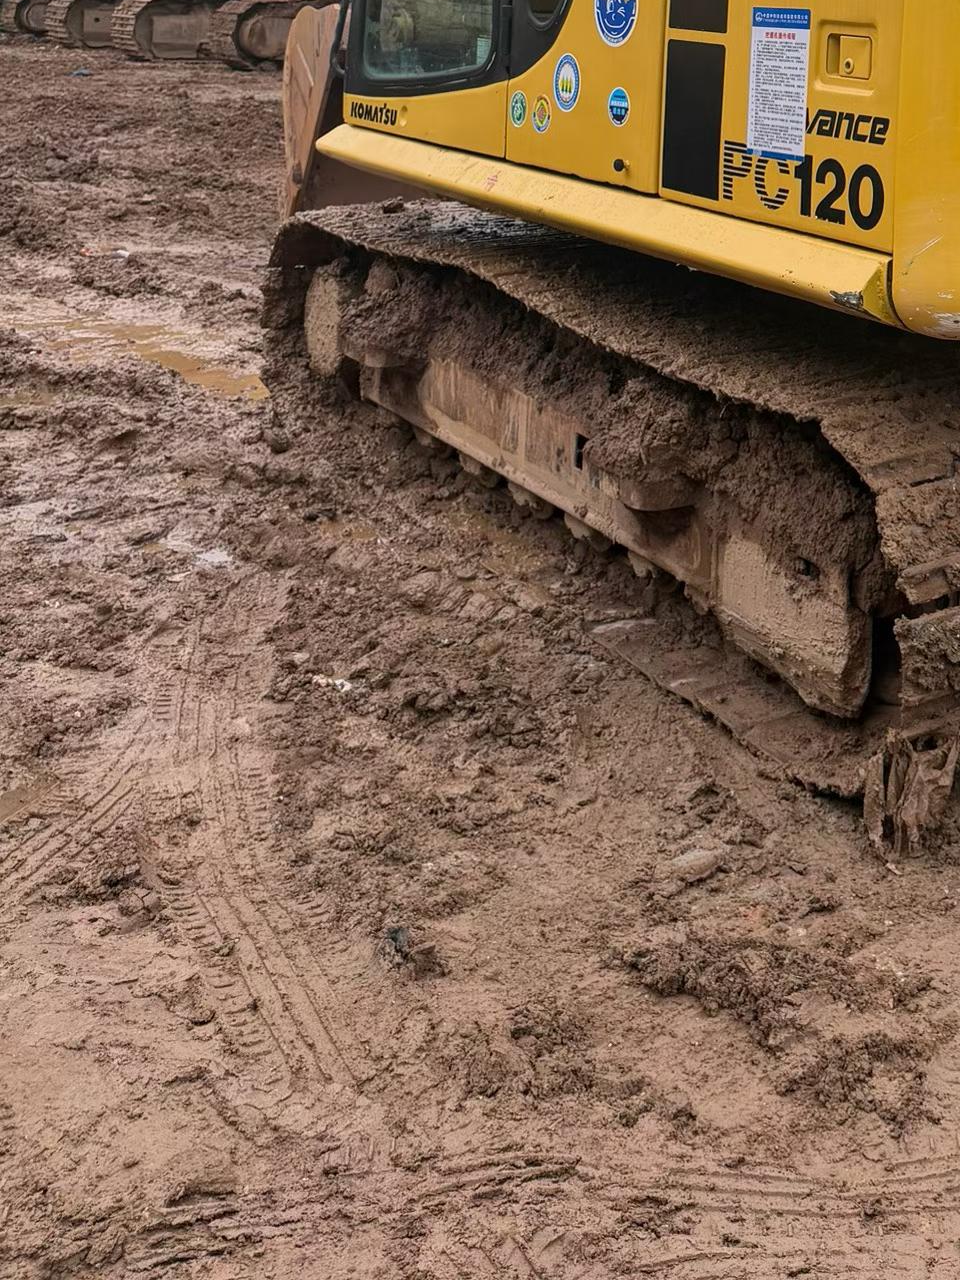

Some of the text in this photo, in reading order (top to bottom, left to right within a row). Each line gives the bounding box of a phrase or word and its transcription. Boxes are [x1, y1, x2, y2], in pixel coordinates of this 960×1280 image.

[350, 101, 398, 126] KOMATSU
[805, 107, 890, 146] vance
[722, 139, 885, 231] PC120
